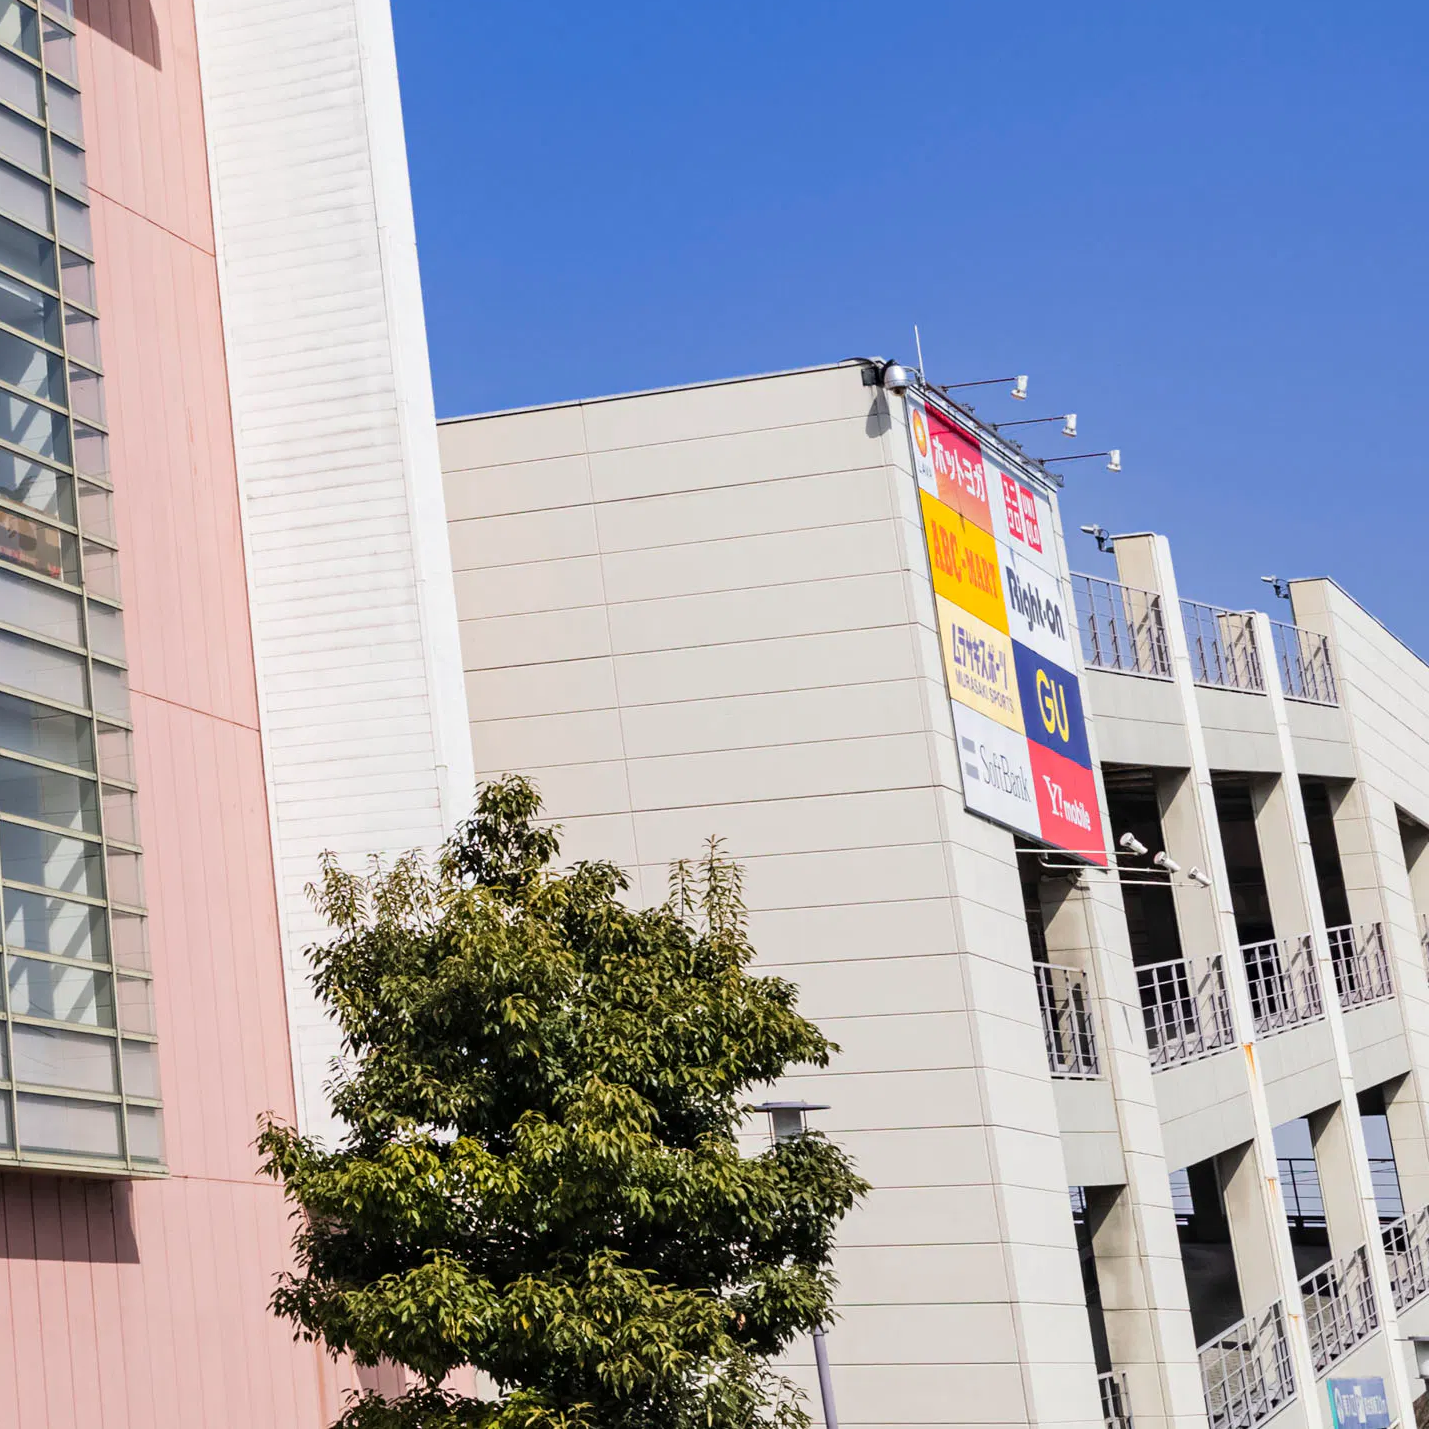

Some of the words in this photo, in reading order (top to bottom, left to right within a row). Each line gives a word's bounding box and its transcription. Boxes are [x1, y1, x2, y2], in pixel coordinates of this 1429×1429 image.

[932, 435, 986, 502] ホットヨガ
[931, 519, 998, 599] ABC-MART
[952, 623, 1008, 690] ムラサキスポーツ
[956, 668, 989, 700] MURASAKI
[989, 687, 1014, 714] SPORTS
[1036, 668, 1069, 743] GU
[980, 745, 1032, 802] SoftBank
